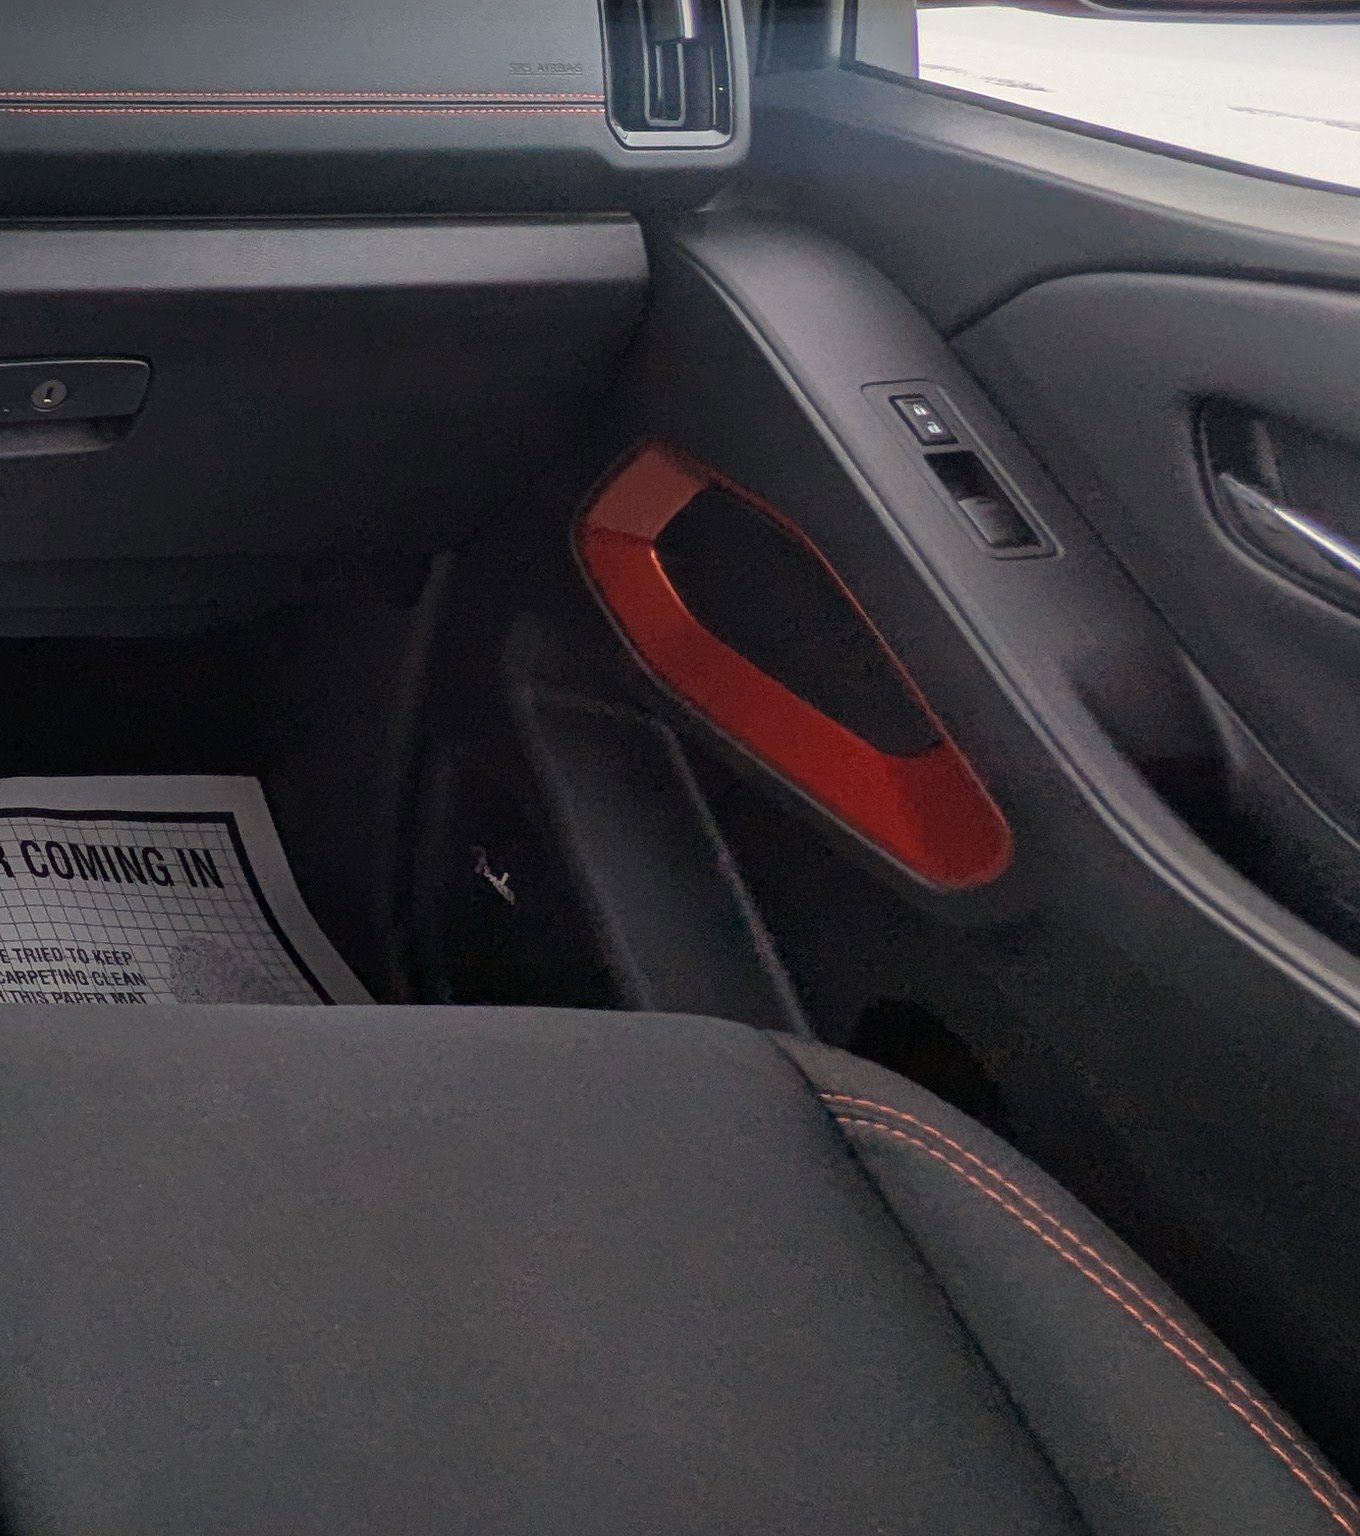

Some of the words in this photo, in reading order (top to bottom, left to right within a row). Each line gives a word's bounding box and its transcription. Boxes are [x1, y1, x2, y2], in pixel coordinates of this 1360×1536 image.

[20, 839, 175, 886] COMING
[176, 848, 225, 889] IN
[12, 947, 64, 963] TRIED
[65, 947, 90, 964] TO
[92, 950, 132, 965] KEEP
[91, 971, 147, 986] CLEAN
[10, 989, 50, 1004] THIS
[53, 990, 108, 1004] PAPER
[109, 992, 148, 1005] MAT
